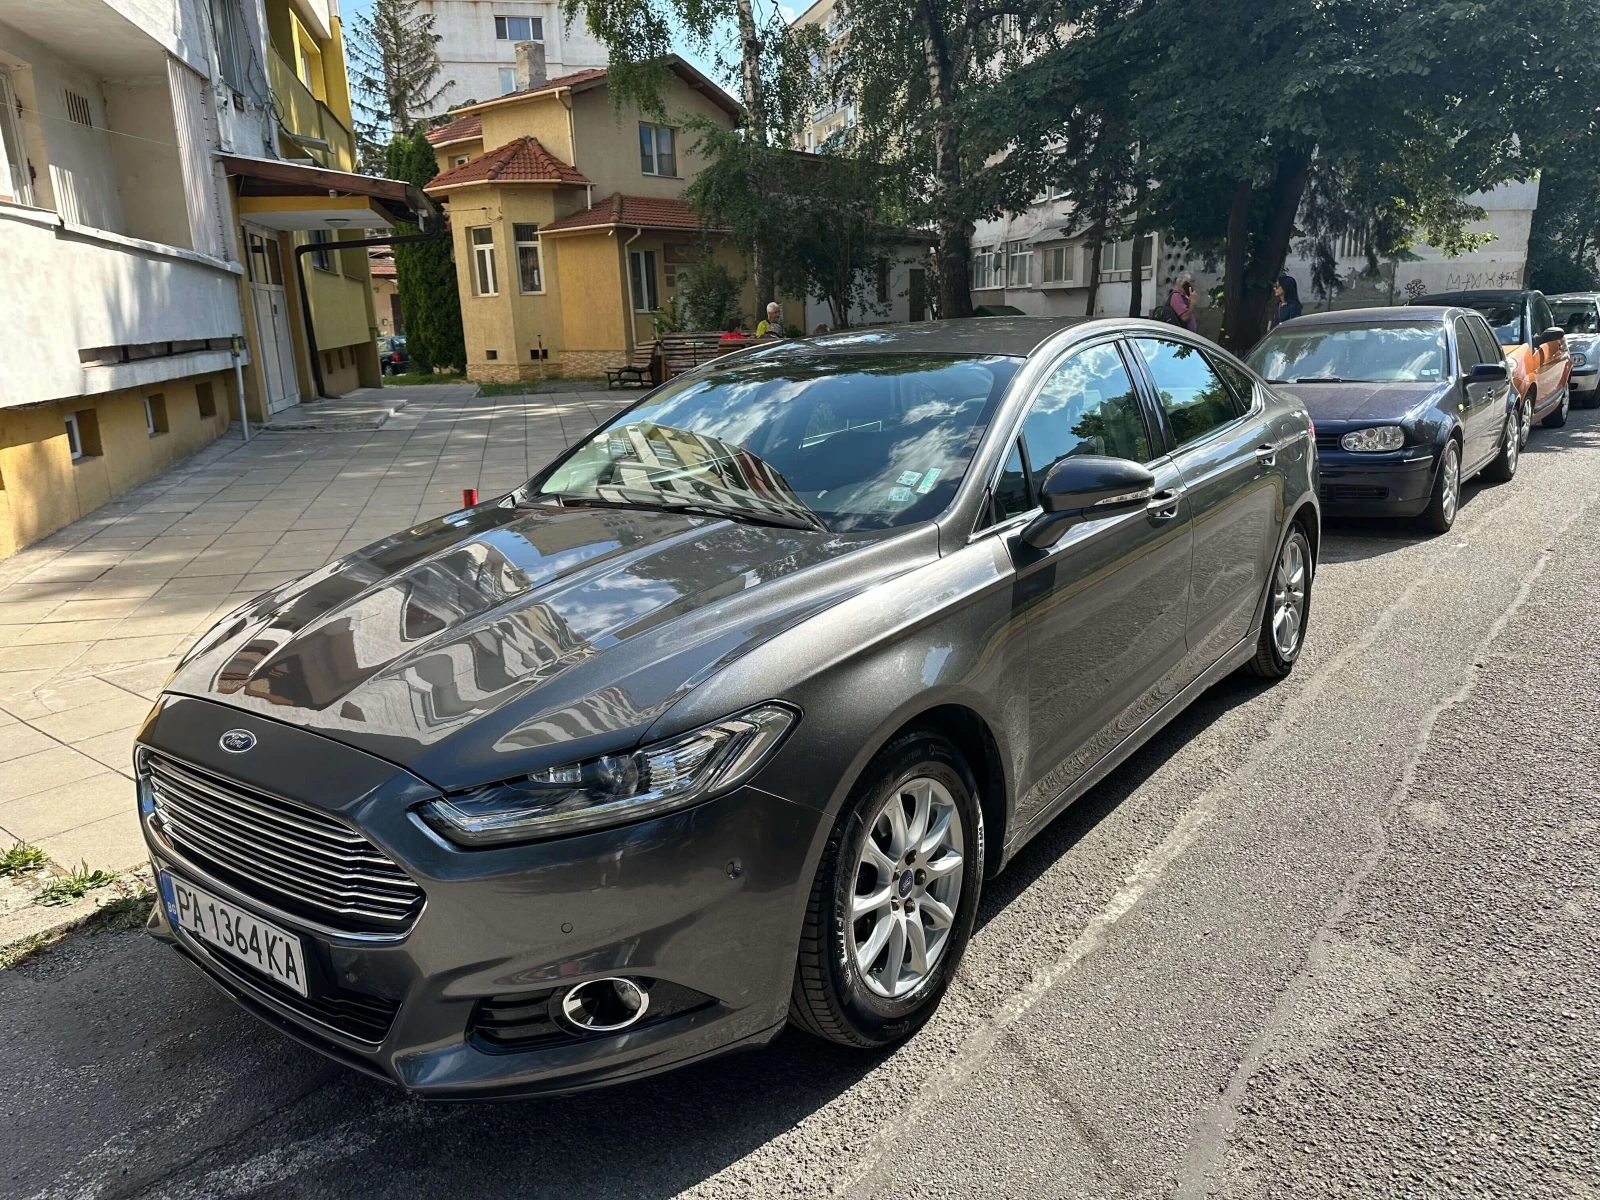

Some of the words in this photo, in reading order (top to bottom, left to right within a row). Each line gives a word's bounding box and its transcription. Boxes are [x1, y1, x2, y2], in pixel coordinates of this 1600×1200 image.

[167, 901, 177, 915] BG
[175, 884, 206, 933] PA
[209, 903, 263, 964] 1364
[265, 930, 300, 985] KA
